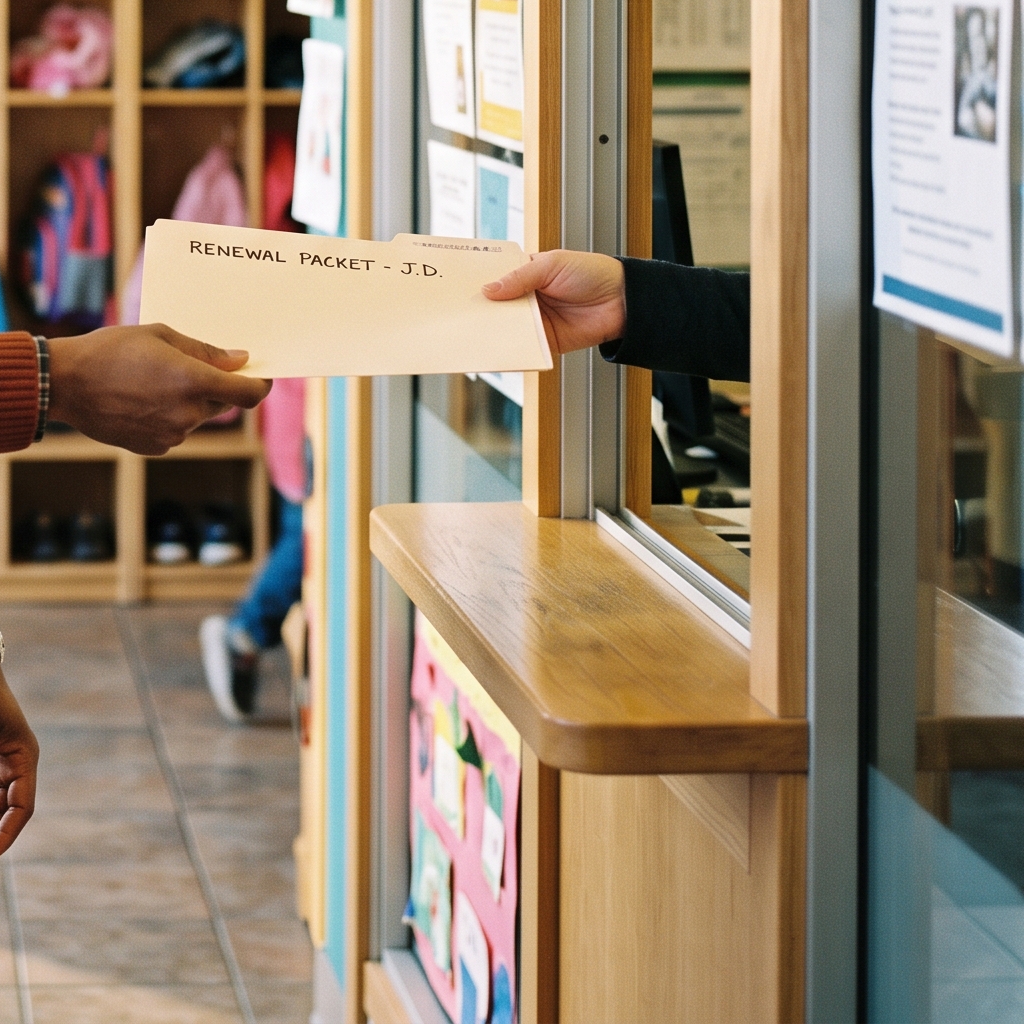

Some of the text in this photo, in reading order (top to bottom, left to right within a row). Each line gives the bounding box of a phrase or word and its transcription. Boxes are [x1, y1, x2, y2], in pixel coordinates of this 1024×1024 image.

[189, 240, 287, 264] RENEWAL
[299, 252, 375, 271] PACKET
[401, 261, 444, 278] J.D.
